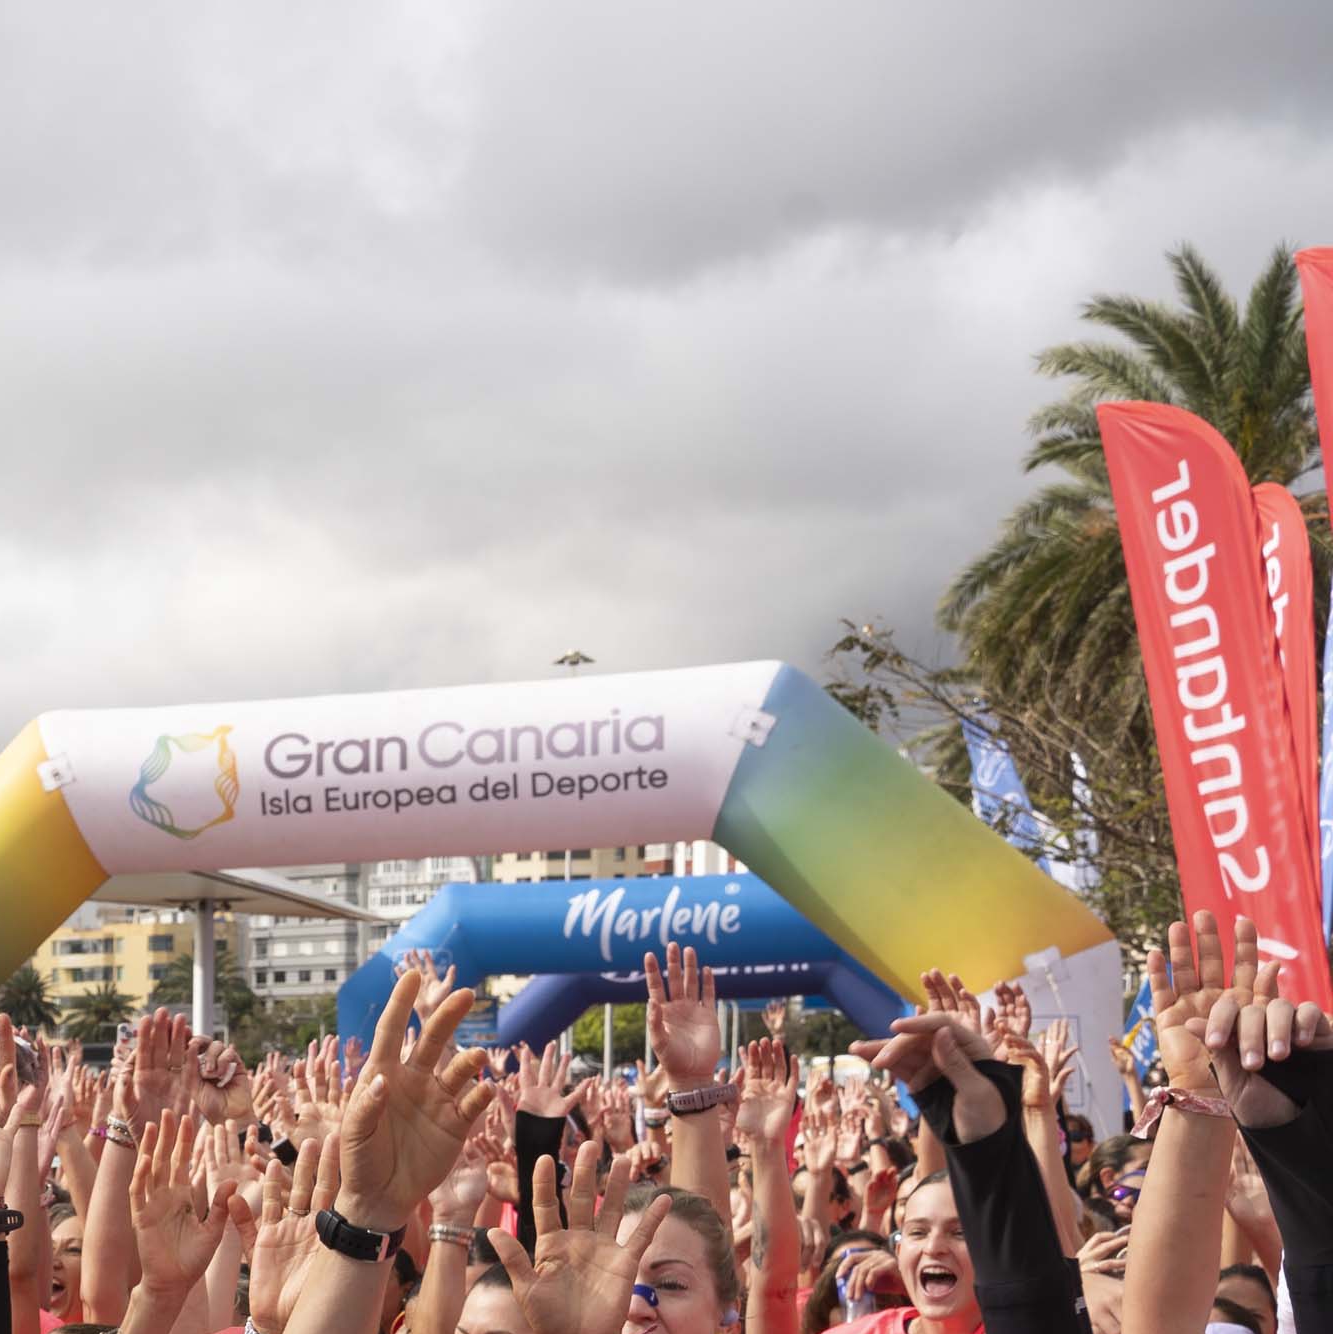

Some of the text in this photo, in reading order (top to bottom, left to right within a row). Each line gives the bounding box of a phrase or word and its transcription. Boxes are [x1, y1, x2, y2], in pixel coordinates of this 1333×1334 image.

[264, 708, 665, 778] Gran Canaria
[261, 764, 668, 816] Isla Europea del Deporte
[562, 885, 741, 962] Marlene
